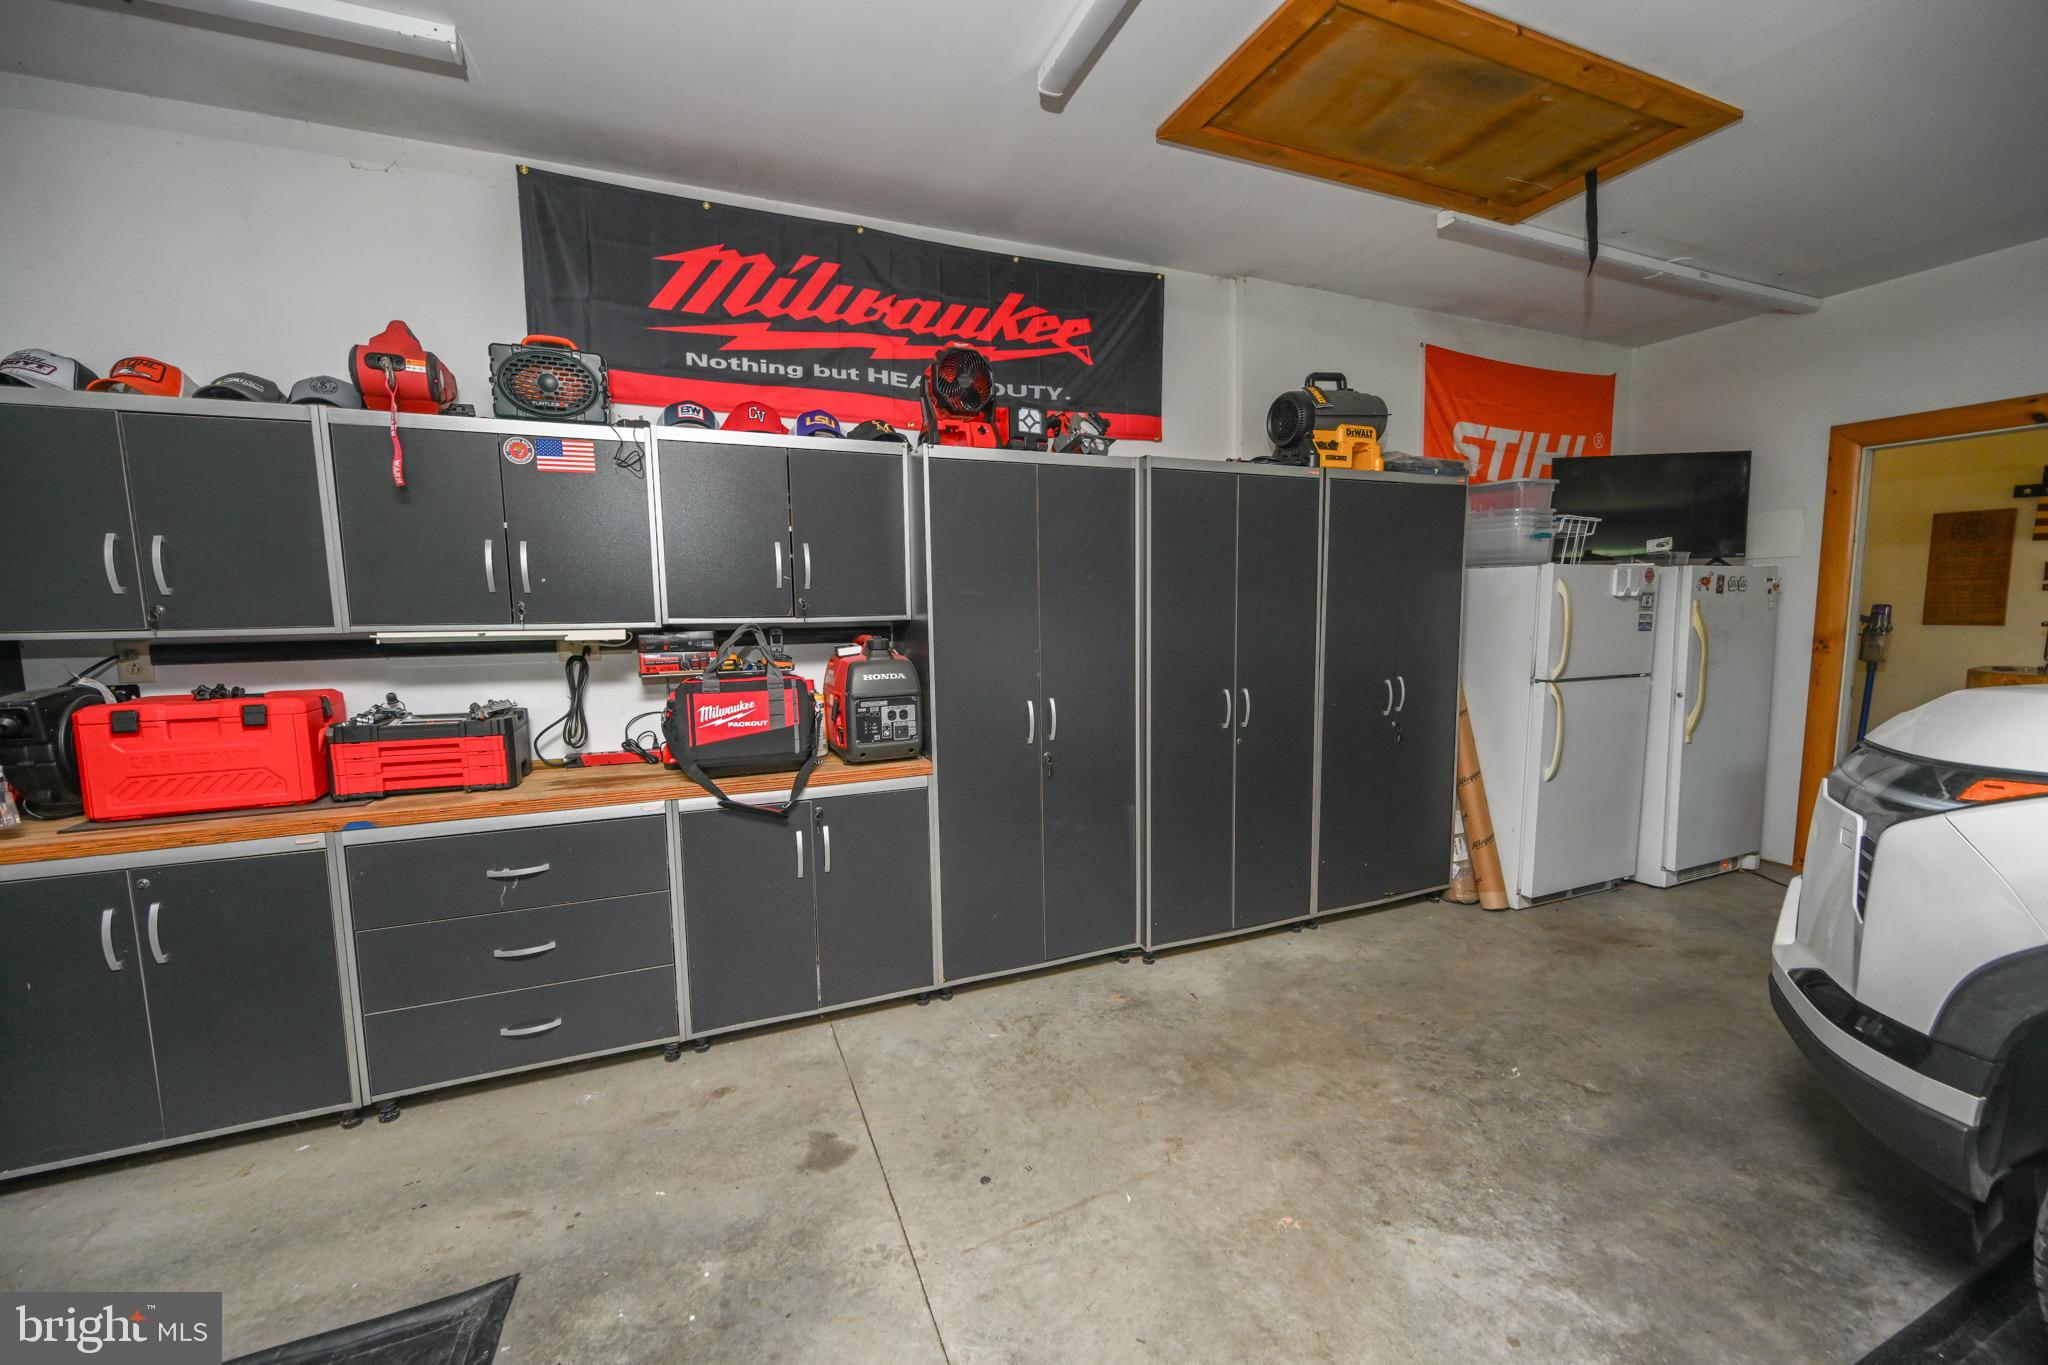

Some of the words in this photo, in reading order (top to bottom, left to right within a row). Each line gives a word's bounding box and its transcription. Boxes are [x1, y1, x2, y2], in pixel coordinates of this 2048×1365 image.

[648, 244, 1094, 346] Milwaukee
[686, 352, 803, 378] Nothing
[814, 364, 859, 381] but
[867, 367, 922, 389] HEA
[531, 400, 569, 408] TURTLEBOX
[805, 416, 836, 428] LSU
[863, 673, 907, 681] HONDA
[697, 700, 756, 723] Milwaukee
